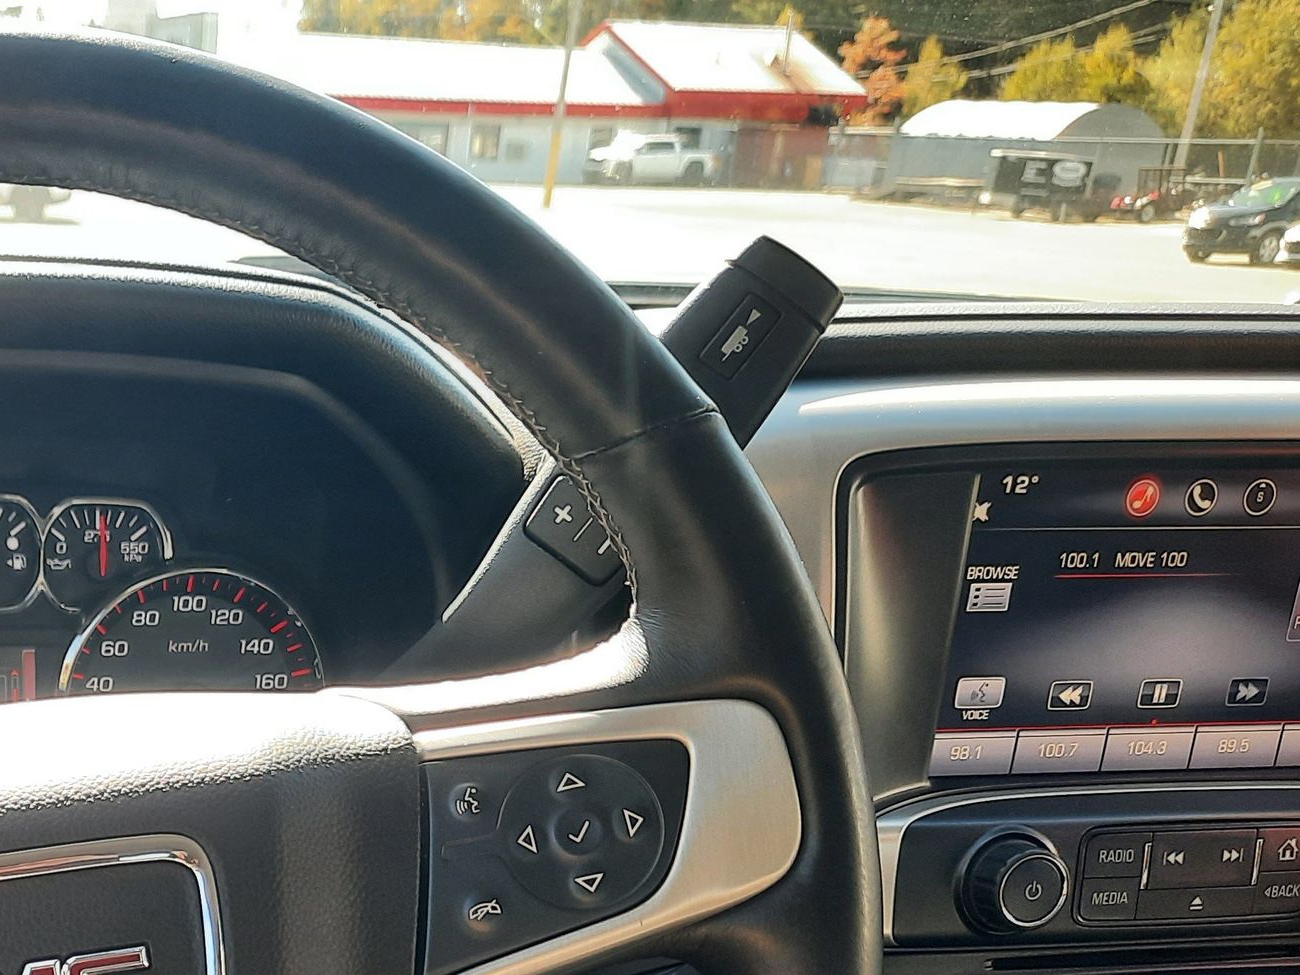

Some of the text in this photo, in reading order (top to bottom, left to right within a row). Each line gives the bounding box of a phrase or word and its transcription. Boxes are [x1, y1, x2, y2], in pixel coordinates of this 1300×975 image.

[1001, 475, 1040, 495] 12°
[121, 542, 149, 555] 550
[1059, 551, 1188, 568] 100.1 MOVE 100
[966, 566, 1020, 580] BROWSE
[172, 595, 207, 613] 100
[132, 610, 160, 627] 80
[209, 608, 243, 626] 120
[100, 640, 129, 657] 60
[168, 637, 209, 655] km/h
[239, 638, 274, 655] 140
[85, 676, 114, 693] 40
[254, 673, 288, 690] 160
[962, 709, 990, 721] VOICE
[950, 745, 983, 760] 98.1
[1037, 743, 1079, 758] 100.7
[1127, 740, 1168, 755] 104.3
[1217, 739, 1251, 753] 89.5
[1098, 848, 1135, 864] RADIO
[1091, 890, 1129, 906] MEDIA
[1271, 884, 1300, 898] BACK
